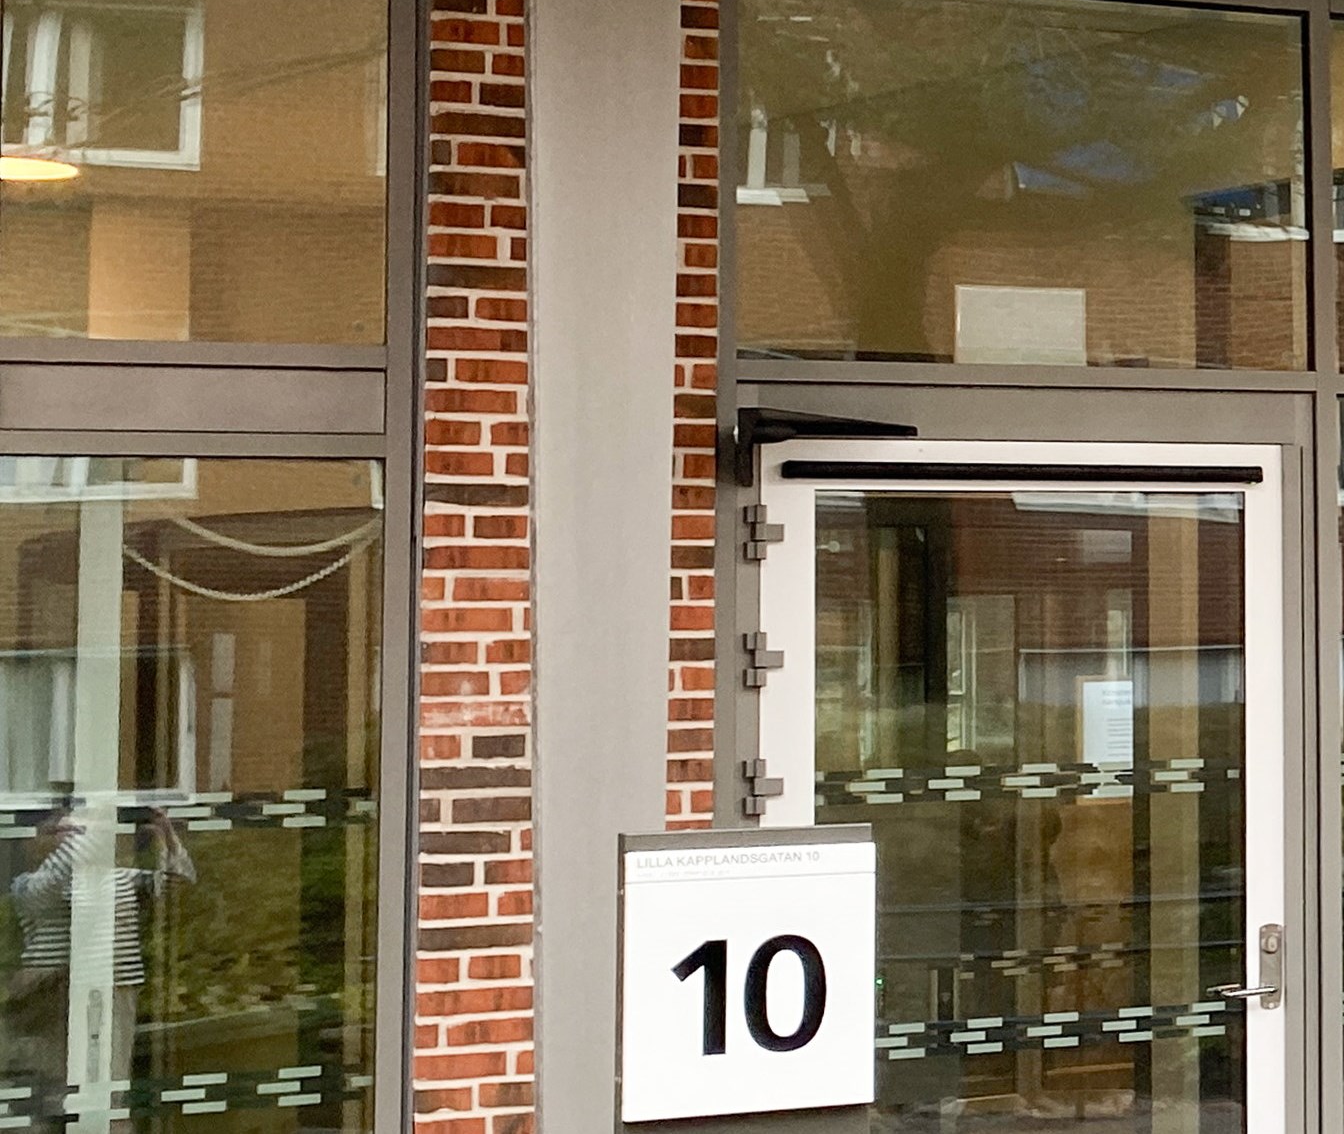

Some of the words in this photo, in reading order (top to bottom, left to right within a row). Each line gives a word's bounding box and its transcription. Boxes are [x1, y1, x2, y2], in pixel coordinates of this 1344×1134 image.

[636, 856, 673, 869] LILLA
[676, 850, 802, 867] KAPPLANDSGATAN
[806, 850, 821, 862] 10
[671, 934, 827, 1056] 10
